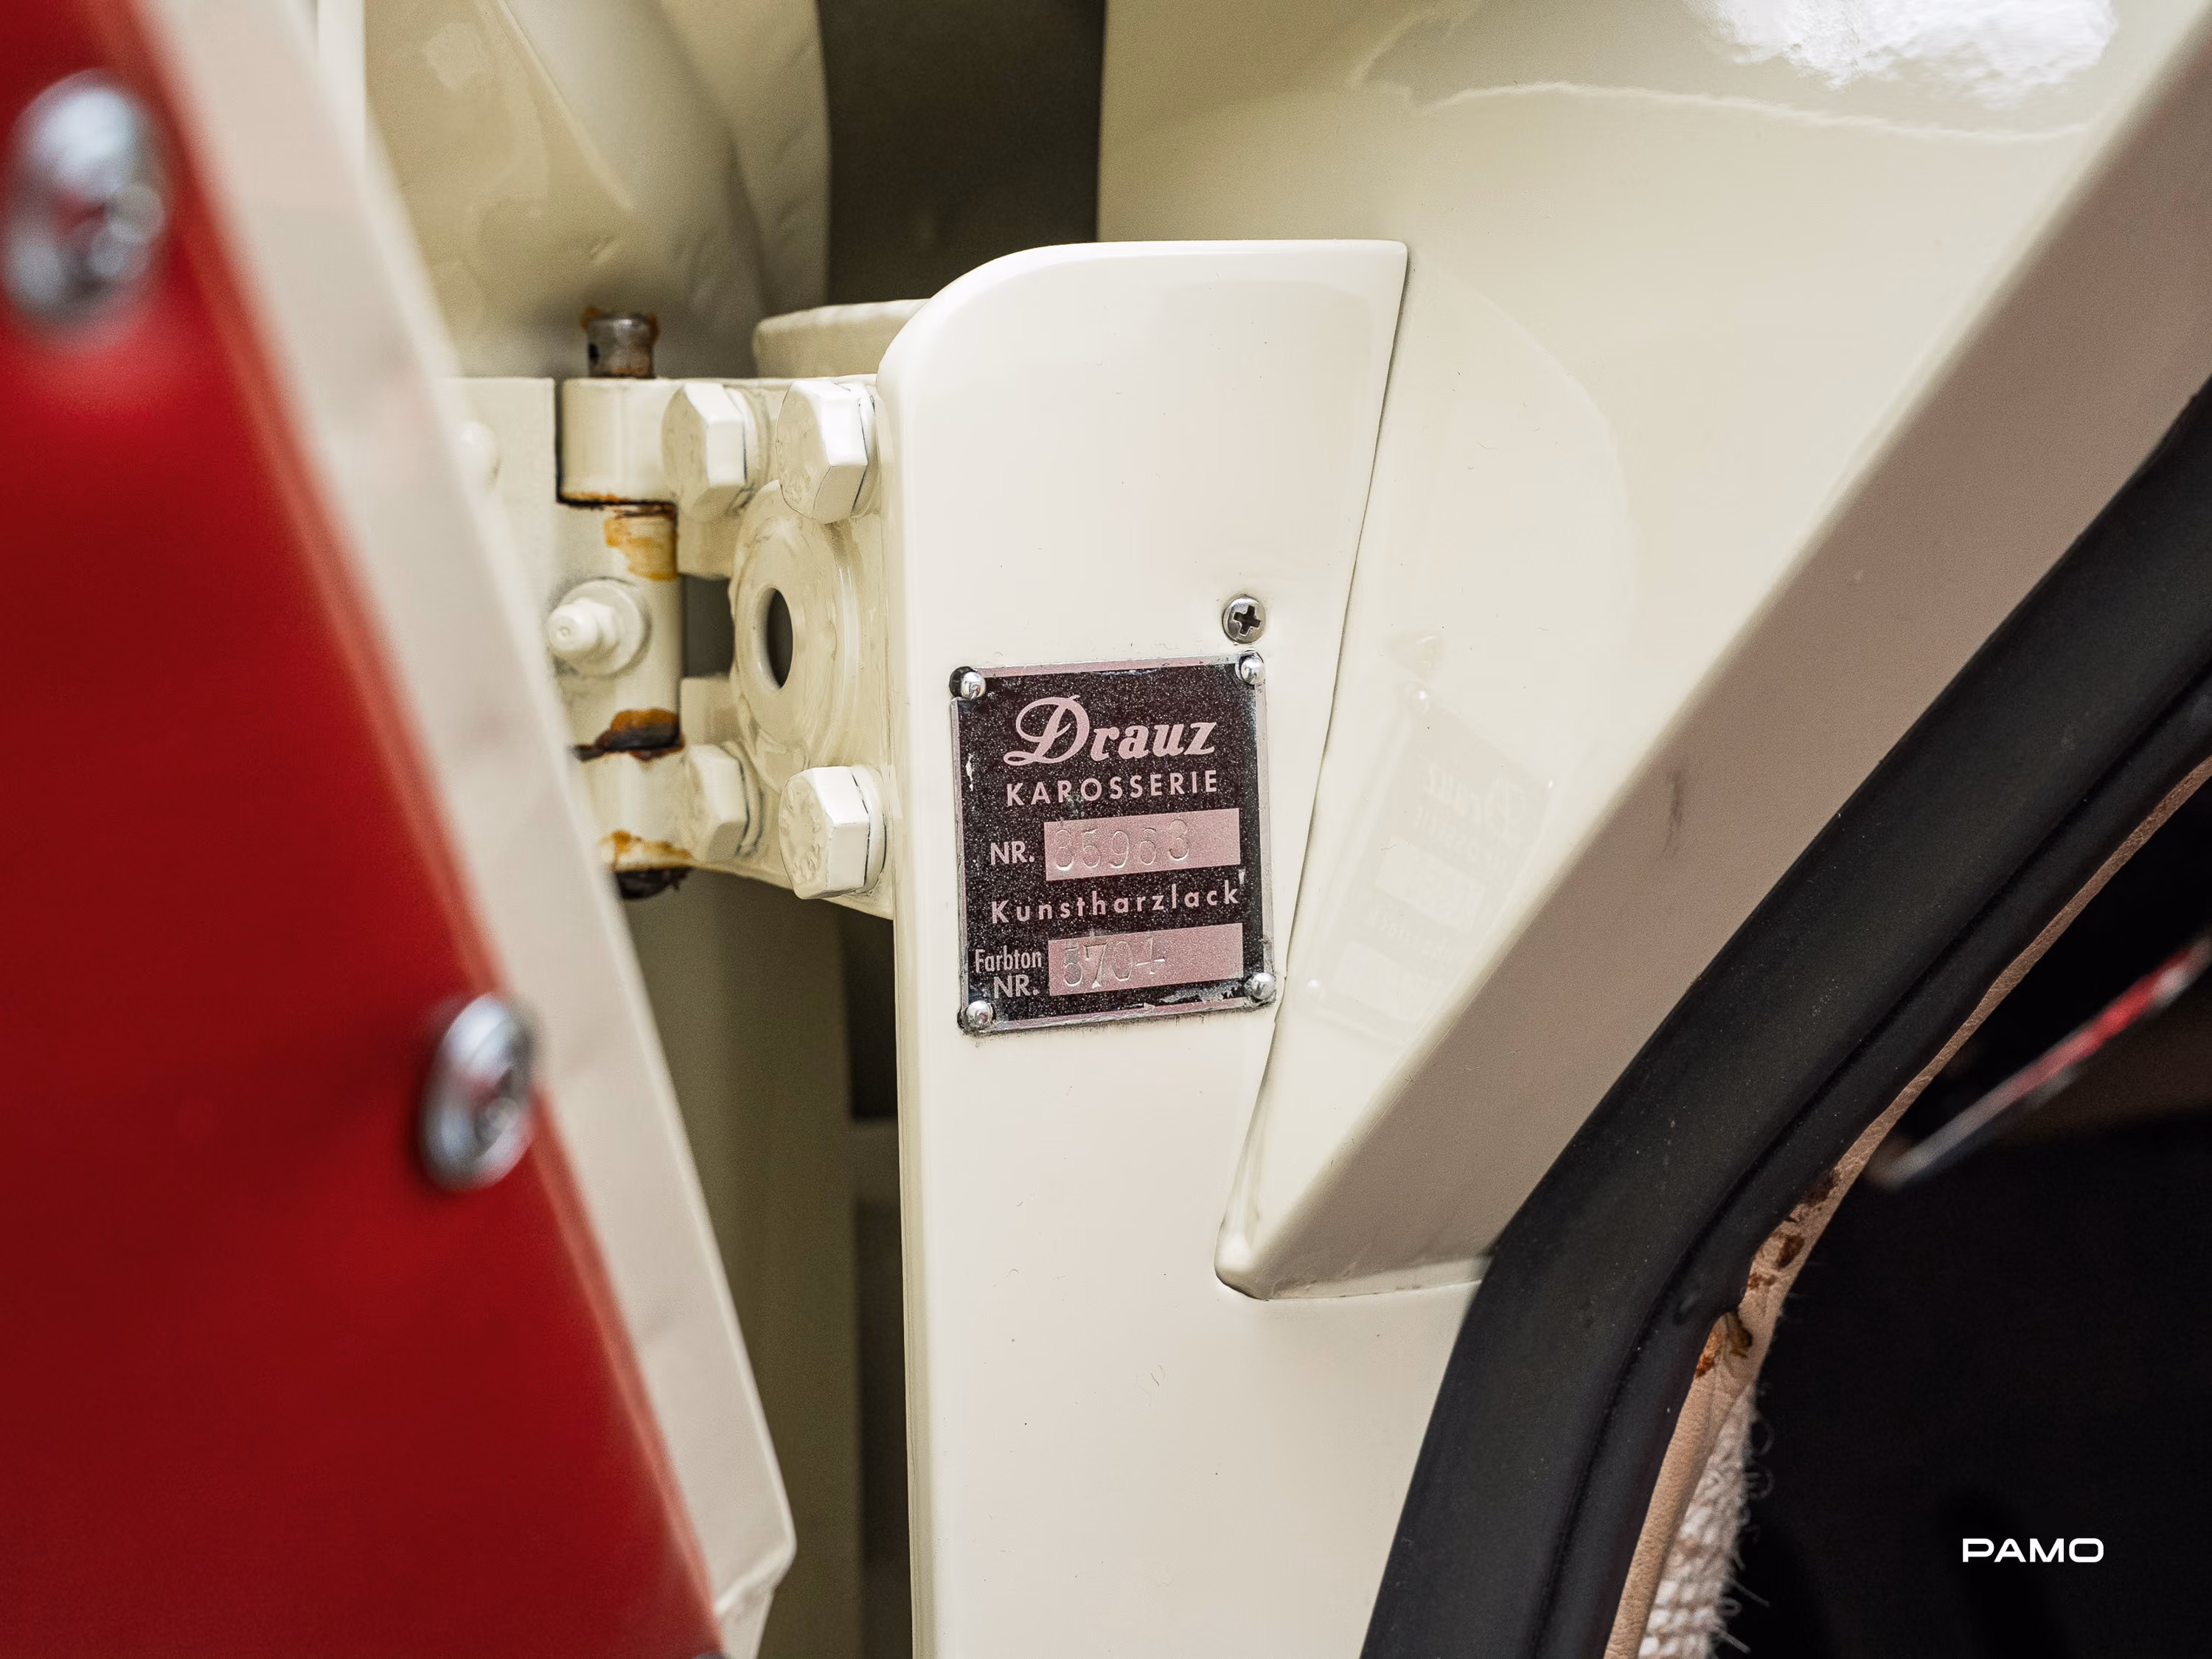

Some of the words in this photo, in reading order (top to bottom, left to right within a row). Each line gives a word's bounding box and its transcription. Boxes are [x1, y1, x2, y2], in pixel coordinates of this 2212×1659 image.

[1004, 695, 1217, 766] Drauz
[1007, 770, 1217, 806] KAROSSERIE
[990, 841, 1034, 865] NR.
[992, 880, 1239, 923] Kunstharzlack
[975, 945, 1042, 973] Farbton
[993, 974, 1040, 998] NR.
